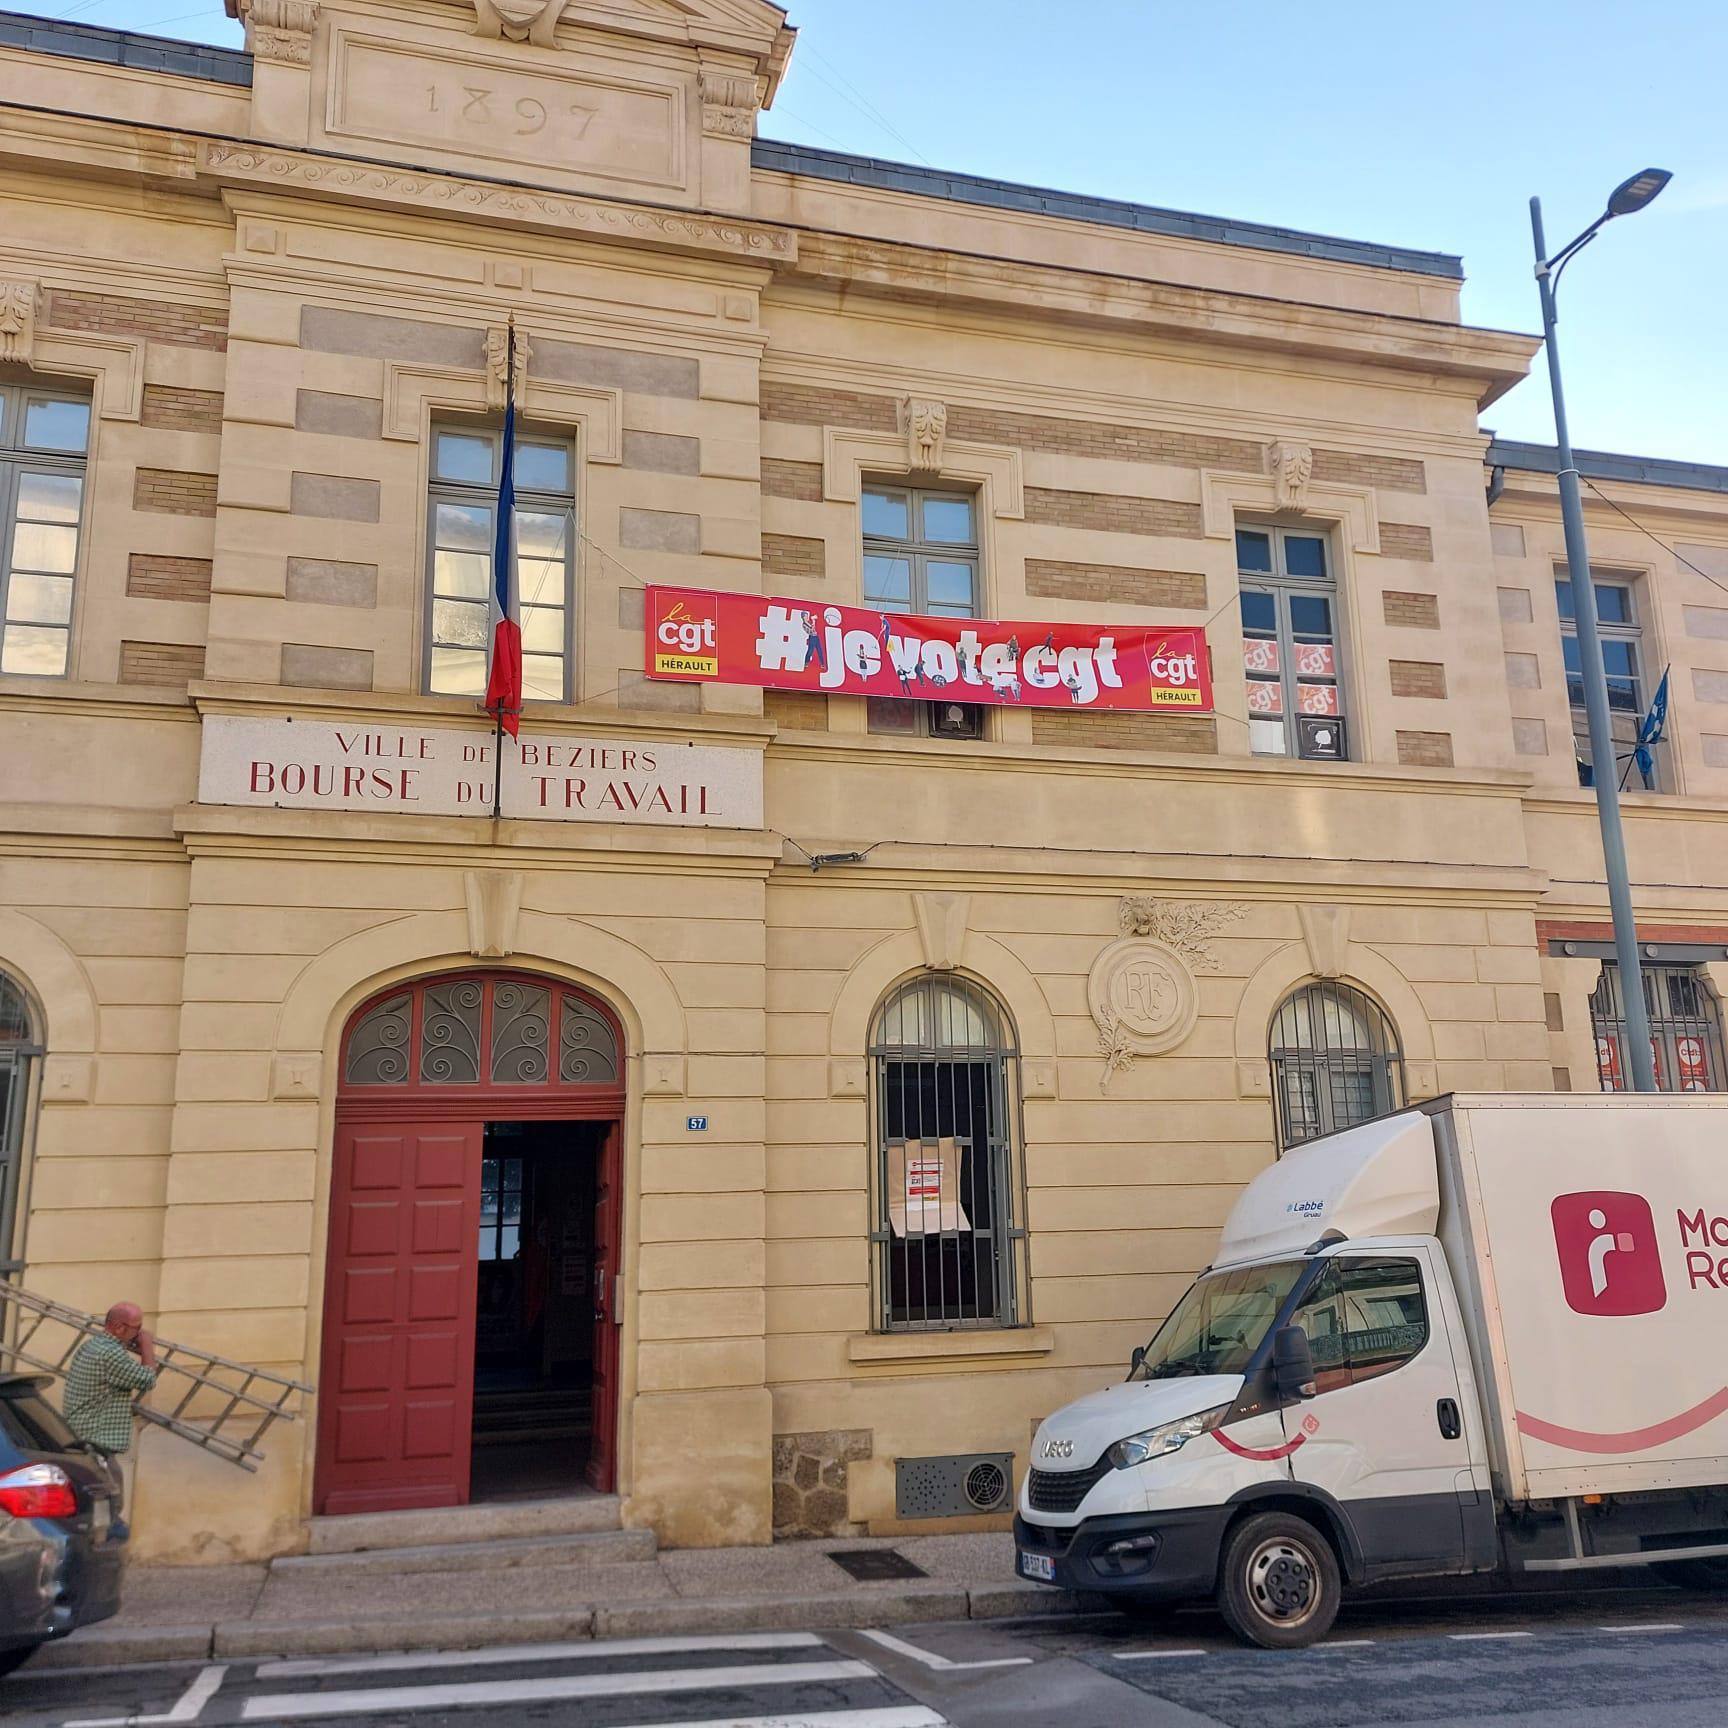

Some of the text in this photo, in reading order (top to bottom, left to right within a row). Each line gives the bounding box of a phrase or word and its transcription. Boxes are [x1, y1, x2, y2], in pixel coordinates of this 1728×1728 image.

[426, 85, 599, 140] 1897
[661, 602, 702, 623] la
[658, 619, 716, 653] cgt
[1151, 642, 1184, 659] la
[1244, 641, 1274, 668] cgt
[1300, 647, 1331, 673] cgt
[661, 658, 712, 671] HÉRAULT
[1151, 654, 1197, 686] cgt
[1156, 690, 1196, 702] HÉRAULT
[1303, 687, 1334, 714] cgt
[335, 732, 657, 772] VILLE DE BEZIERS
[250, 761, 722, 816] BOURSE DU TRAVAIL
[691, 1118, 704, 1129] 57
[1293, 1200, 1324, 1212] Labbé
[1040, 1440, 1074, 1458] IVECO
